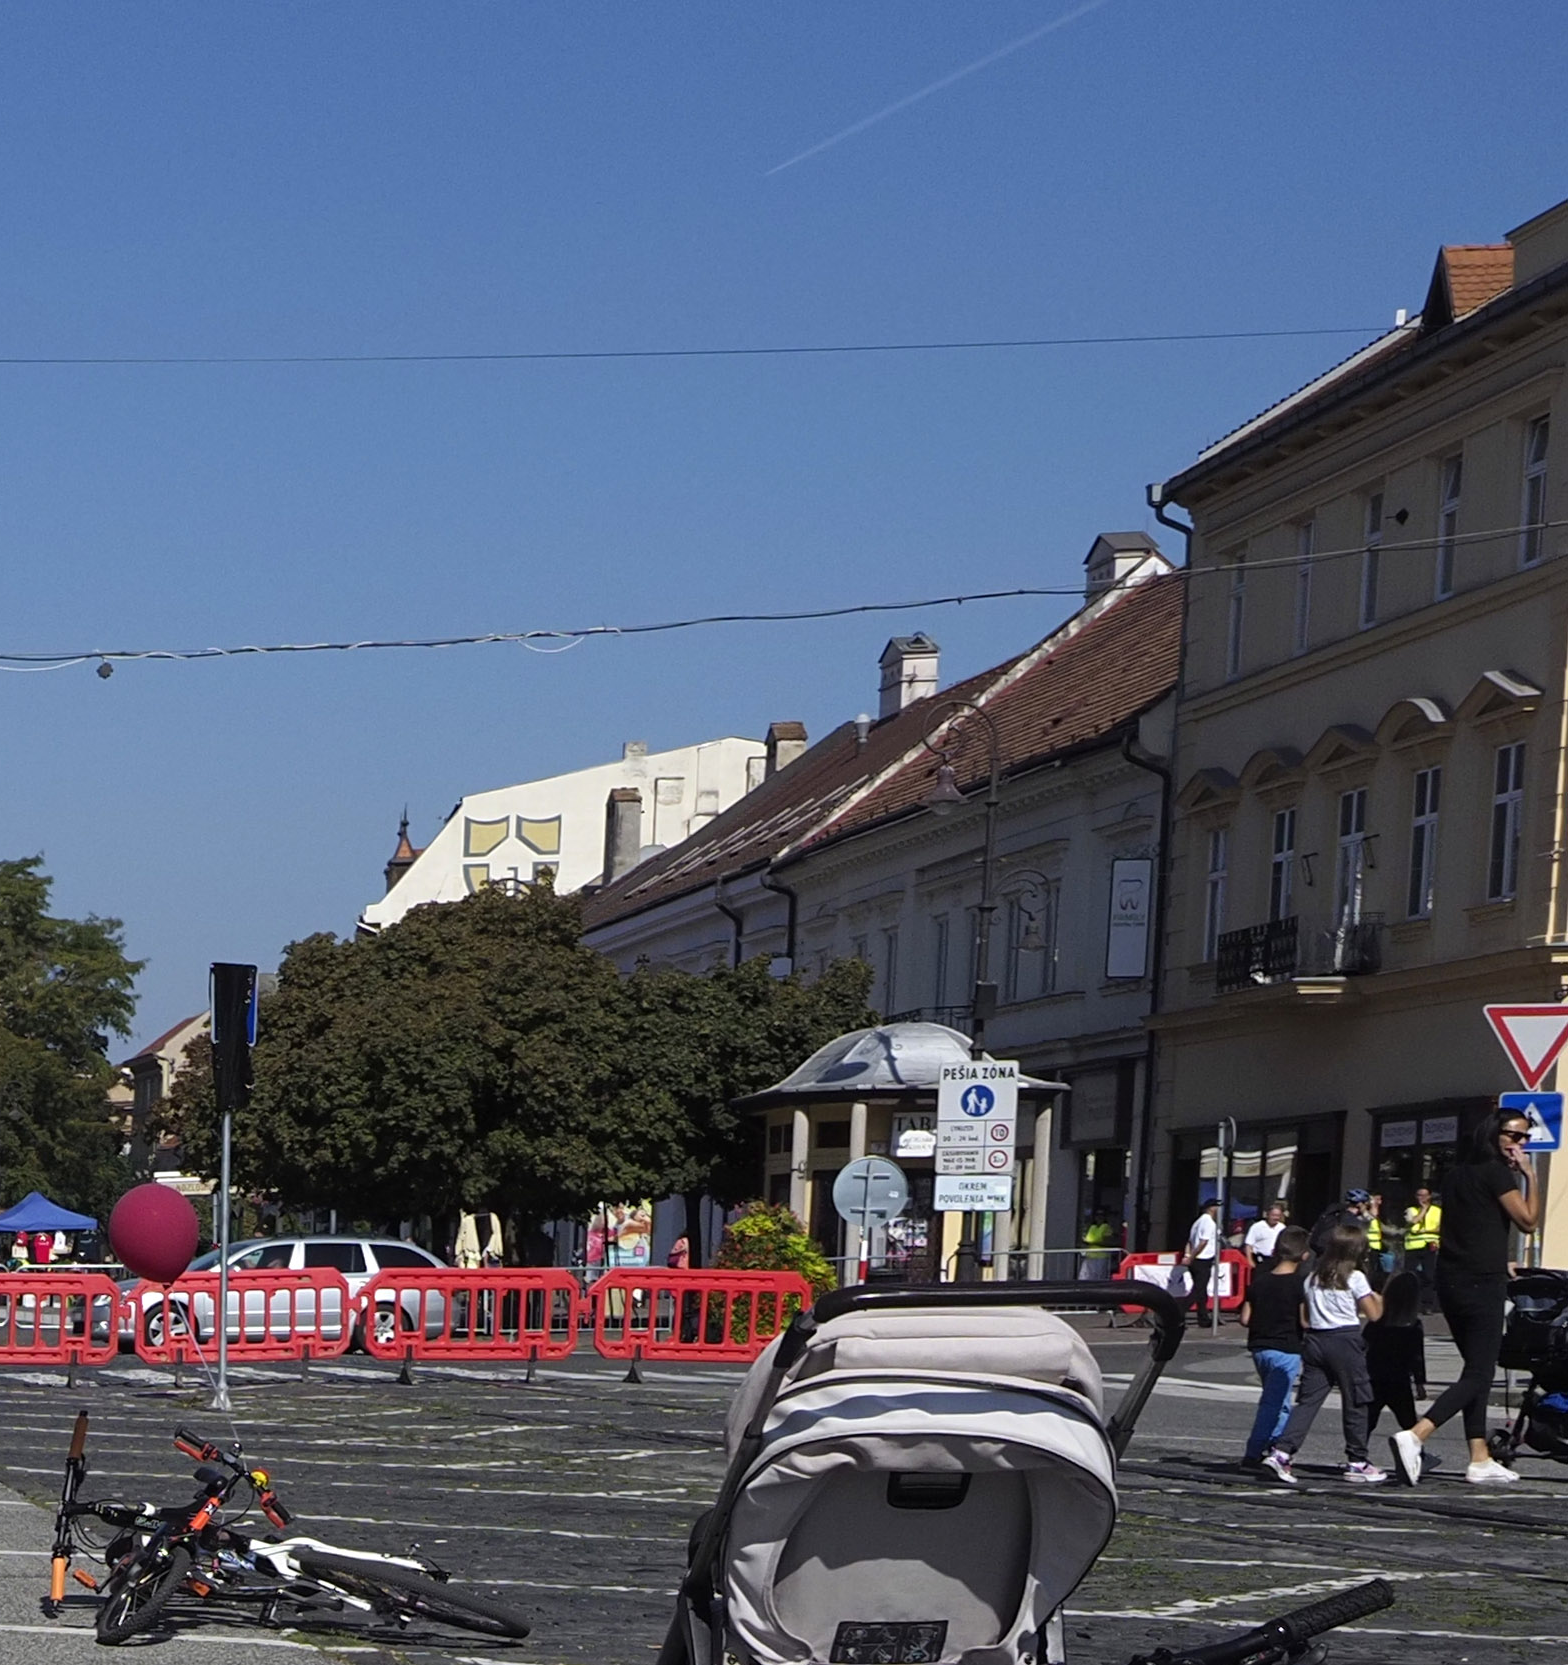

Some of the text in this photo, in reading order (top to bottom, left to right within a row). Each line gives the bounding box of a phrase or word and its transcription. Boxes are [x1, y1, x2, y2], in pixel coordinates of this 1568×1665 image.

[943, 1064, 1016, 1081] PEŠIA ZÓNA
[894, 1116, 931, 1132] TAB
[958, 1181, 987, 1191] OKREM
[938, 1193, 984, 1203] POVOLENIA
